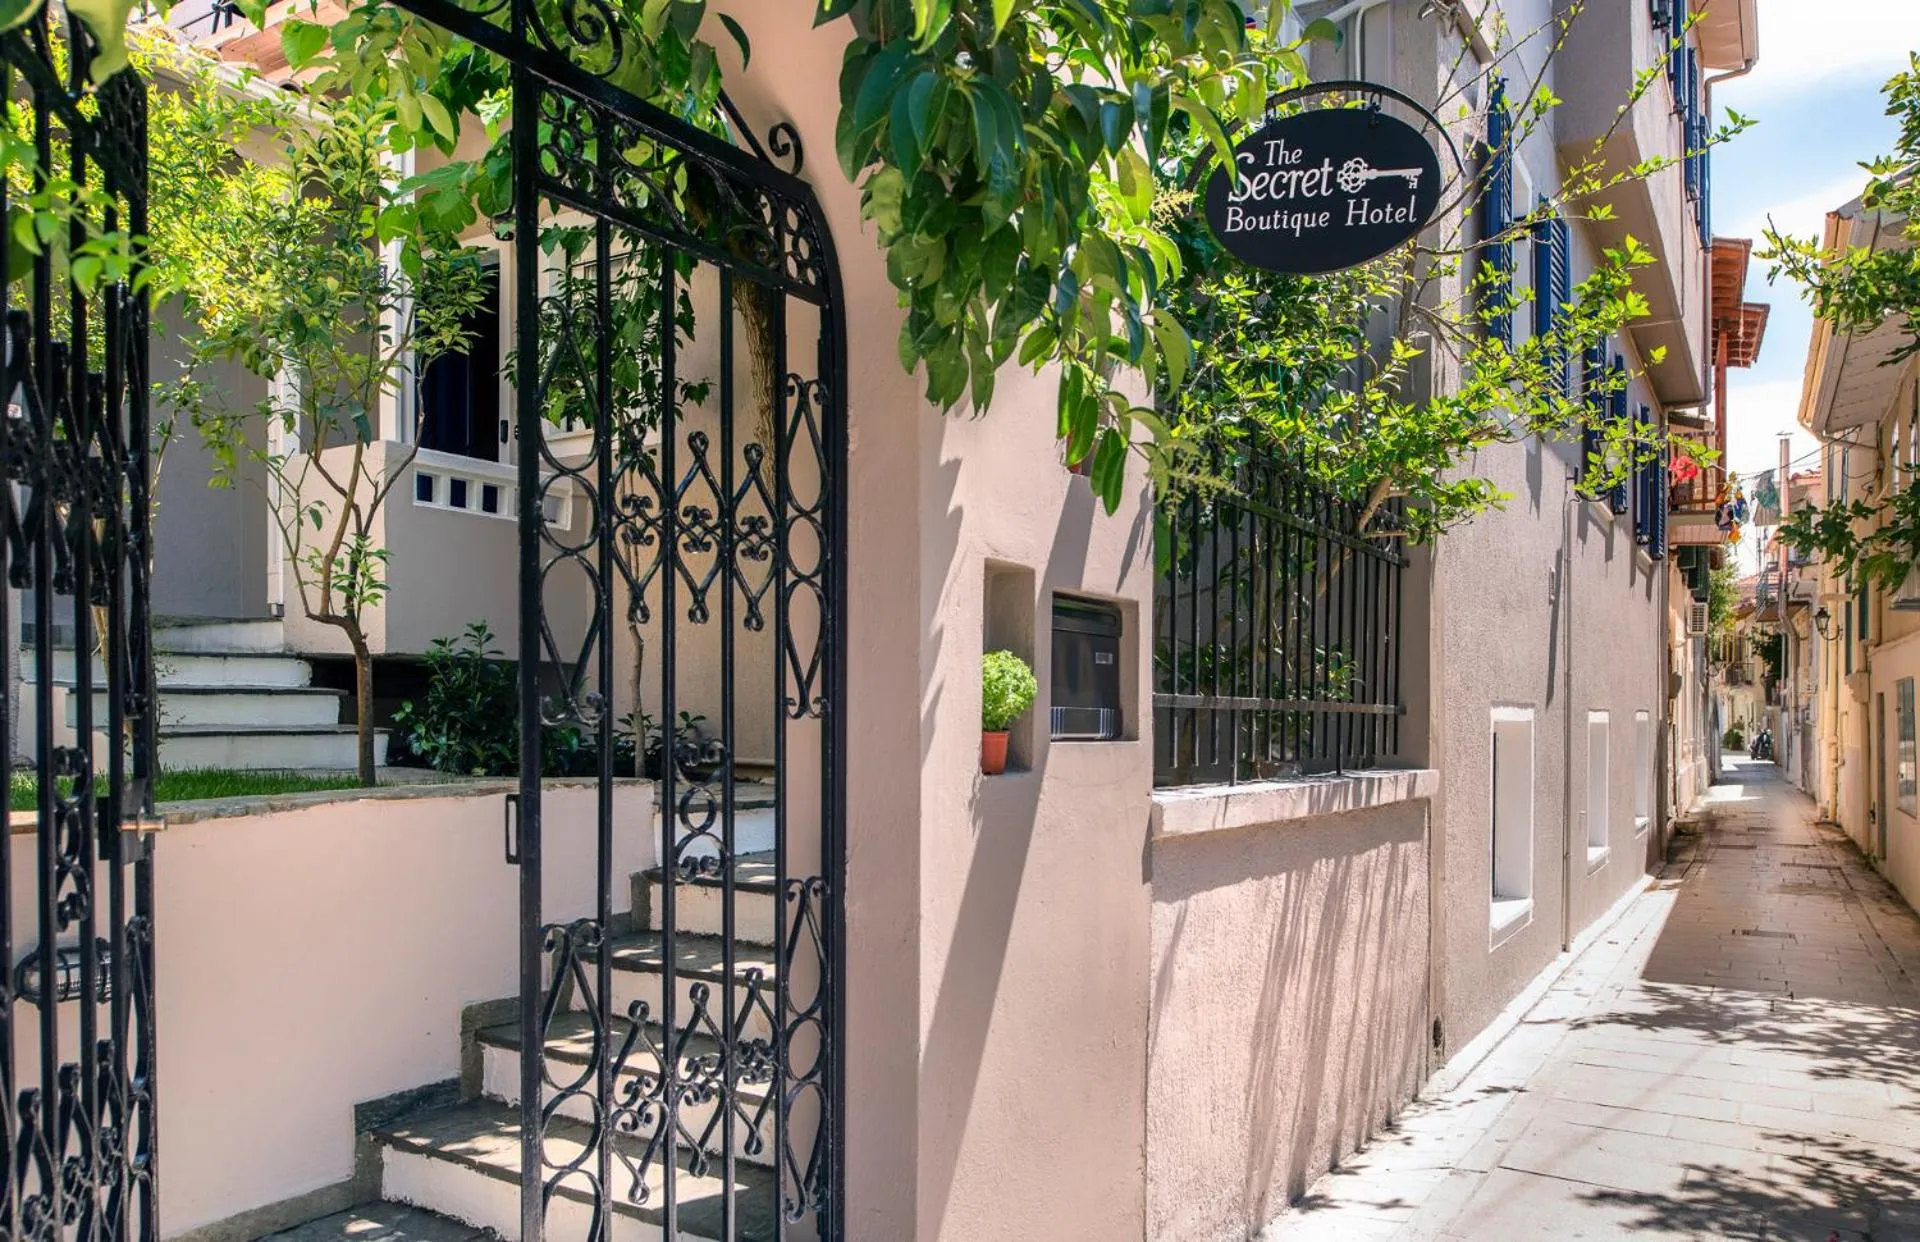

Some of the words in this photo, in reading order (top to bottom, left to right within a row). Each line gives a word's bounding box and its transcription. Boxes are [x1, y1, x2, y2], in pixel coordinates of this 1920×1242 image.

[1263, 138, 1303, 167] The
[1227, 151, 1334, 202] Secret
[1224, 205, 1331, 238] Boutique
[1344, 193, 1417, 228] Hotel
